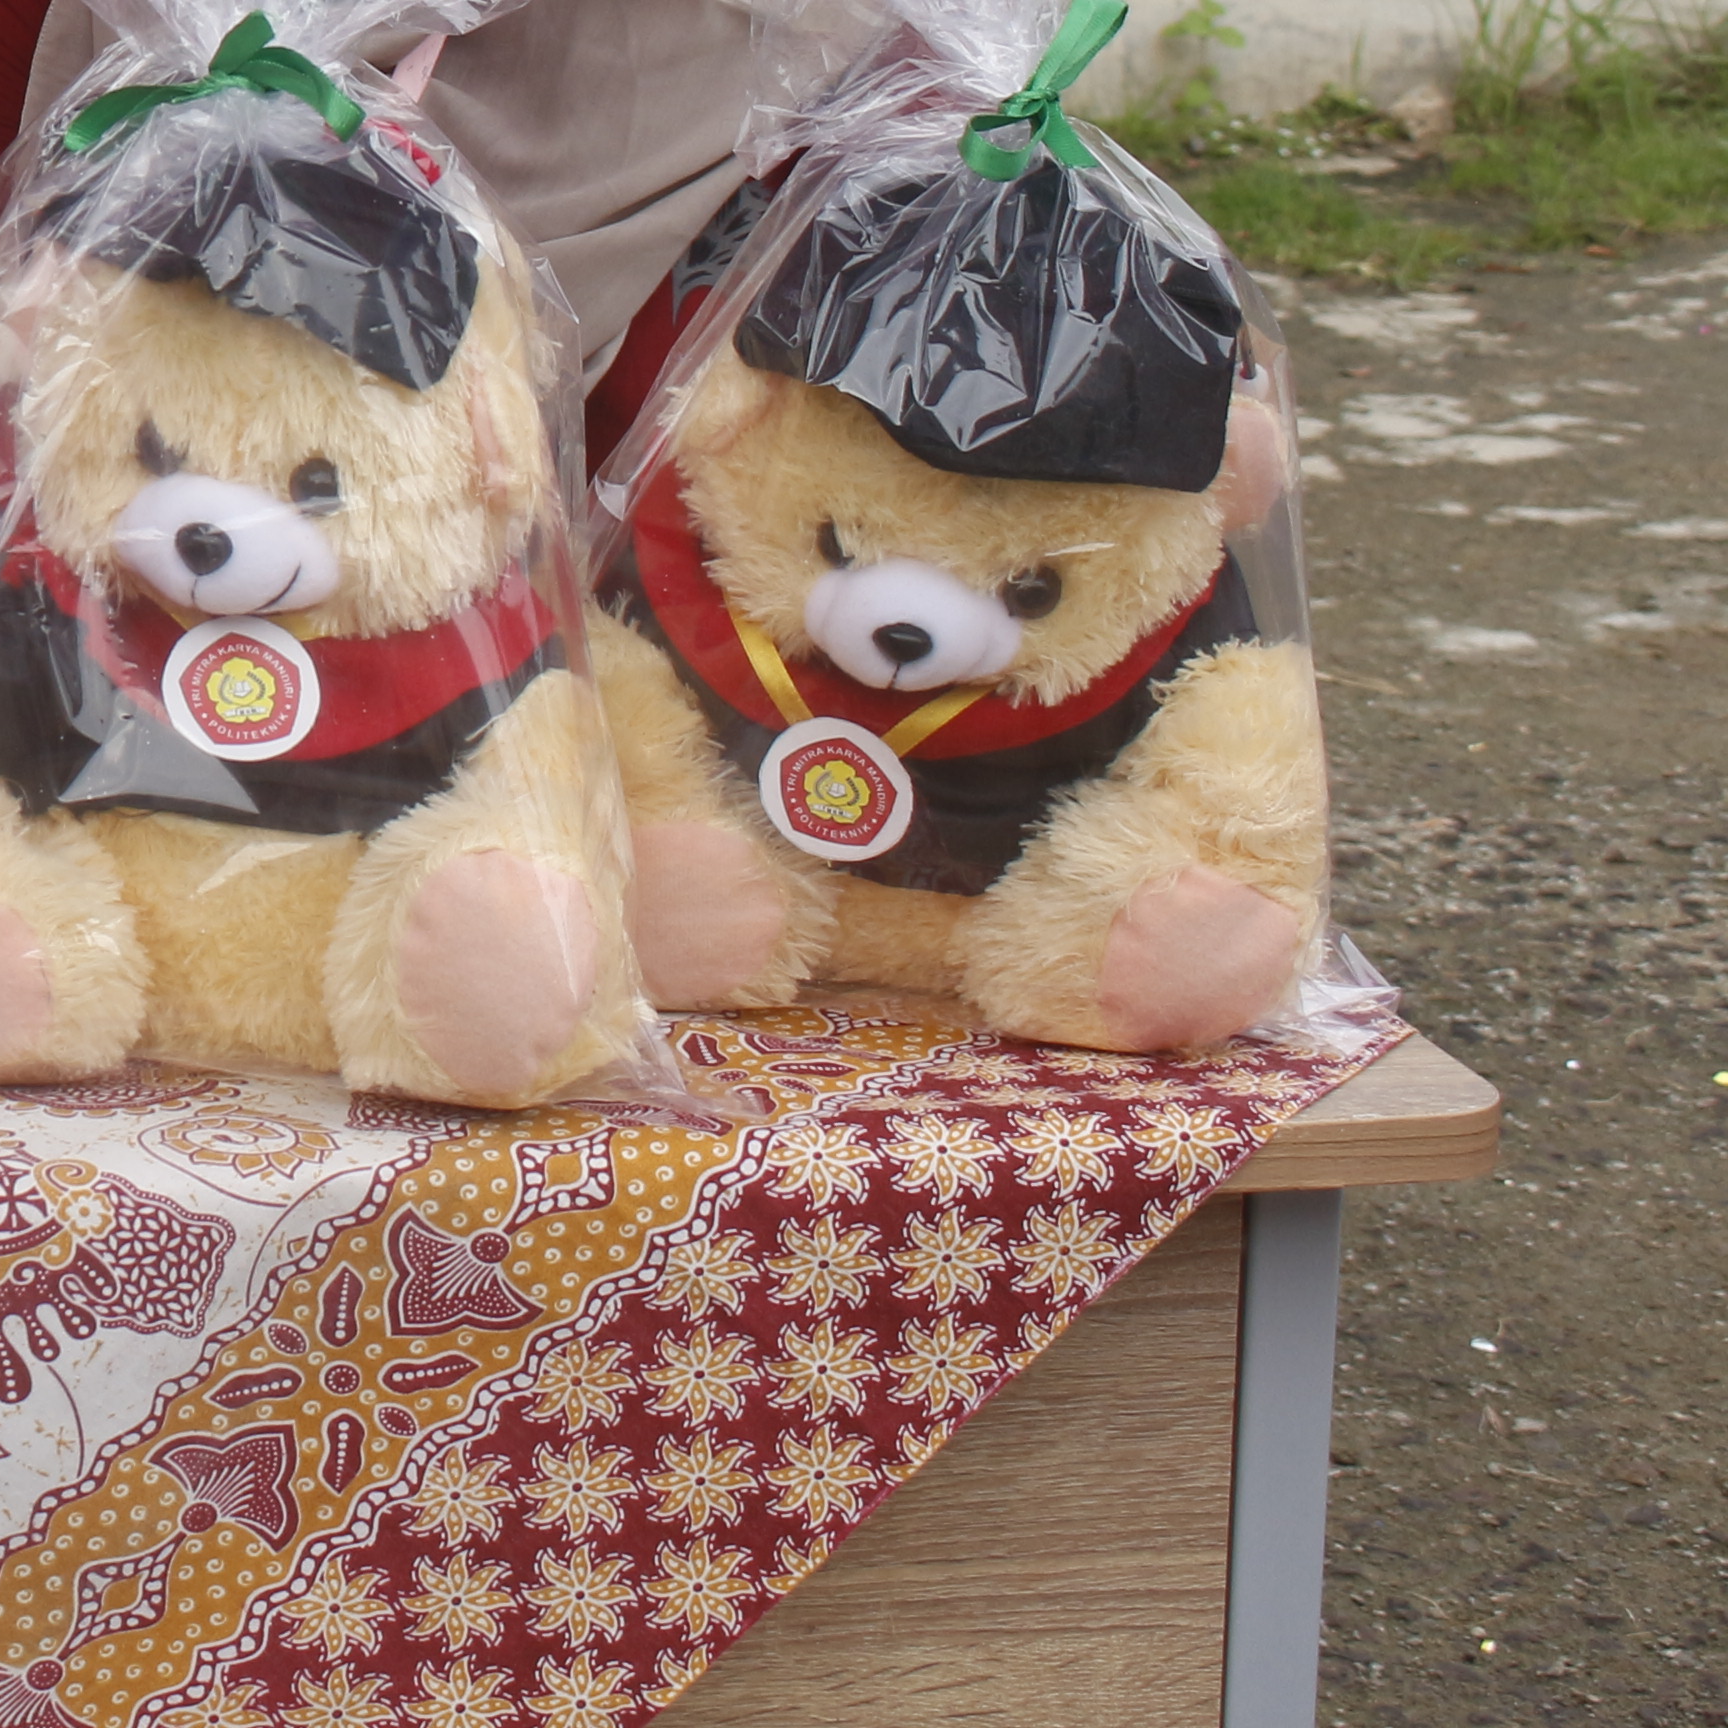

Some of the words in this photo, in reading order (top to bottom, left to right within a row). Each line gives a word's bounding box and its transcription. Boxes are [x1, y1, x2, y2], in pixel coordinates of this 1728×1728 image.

[217, 644, 260, 656] KARYA
[192, 653, 218, 686] MITRA
[262, 652, 294, 699] MANDIRI
[192, 689, 203, 708] TRI
[208, 713, 289, 740] POLITEKNIK
[792, 747, 825, 772] MITRA
[826, 746, 866, 767] KARYA
[787, 773, 798, 792] TRI
[866, 766, 886, 816] MANDIRI
[794, 807, 871, 839] POLITEKNIK
